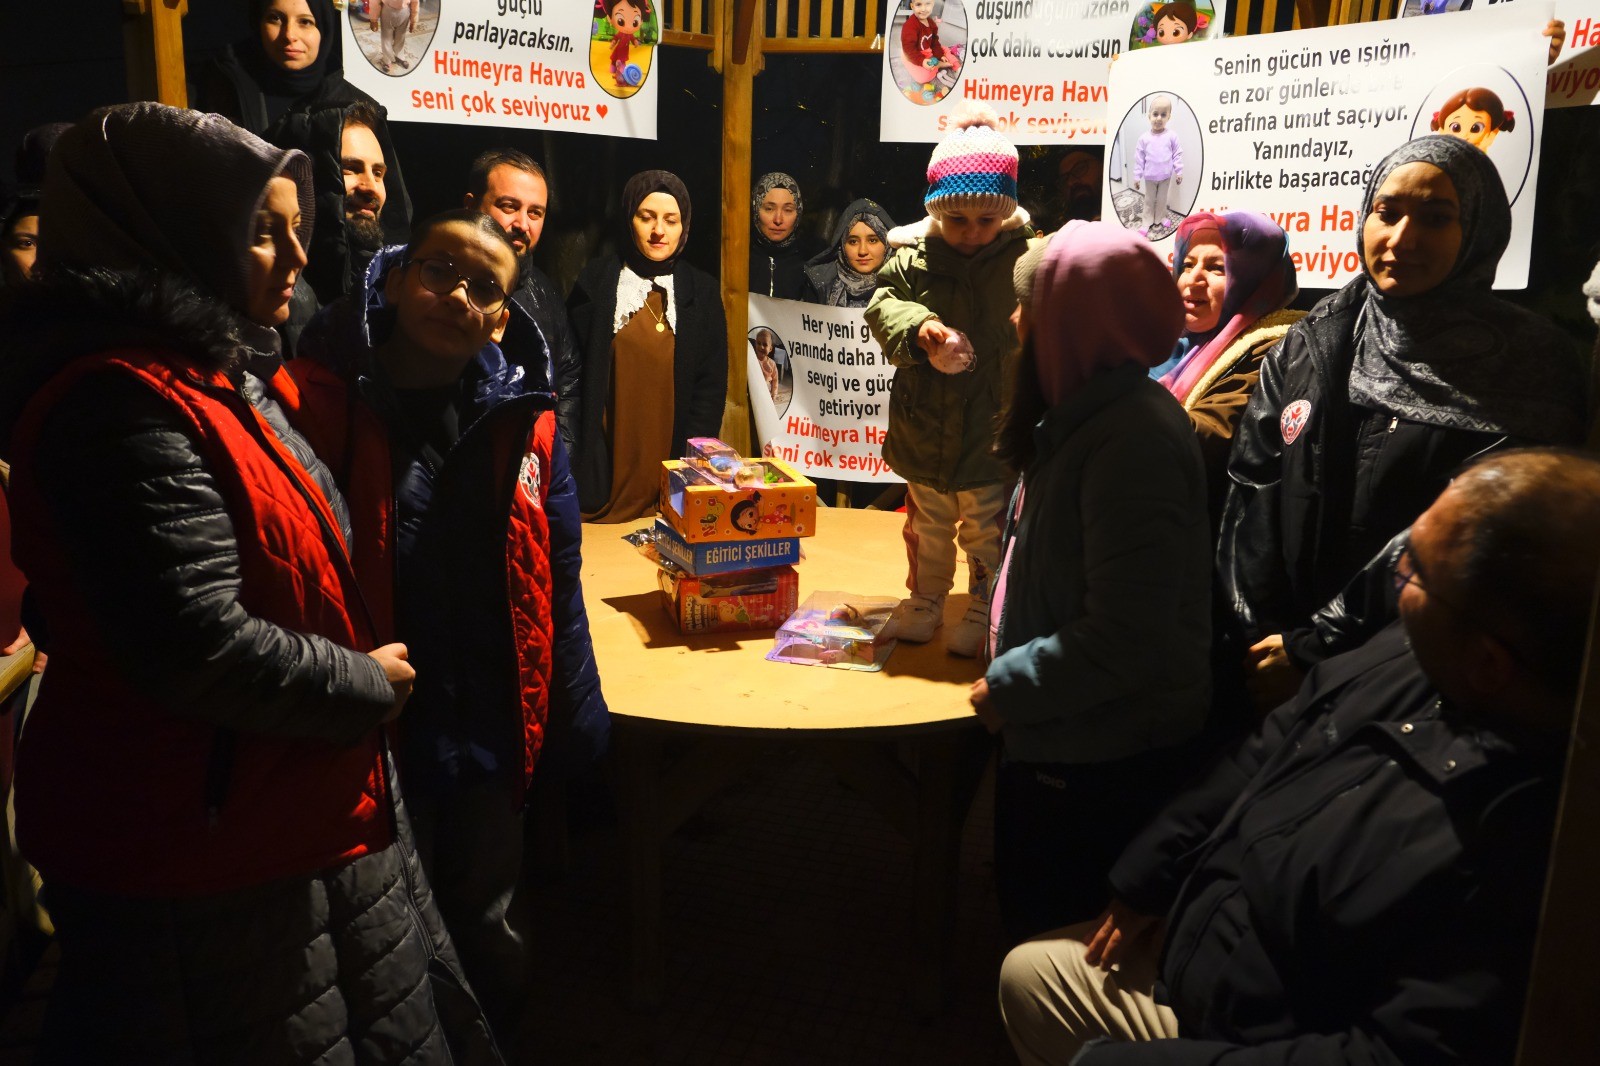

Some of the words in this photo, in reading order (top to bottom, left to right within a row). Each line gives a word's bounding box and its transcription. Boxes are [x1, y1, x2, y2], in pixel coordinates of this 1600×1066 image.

[453, 19, 575, 53] parlayacaksın.
[971, 32, 998, 63] çok
[1003, 32, 1042, 58] daha
[433, 50, 523, 87] Hümeyra
[530, 61, 586, 90] Havva
[1213, 56, 1261, 77] Senin
[1267, 47, 1322, 77] gücün
[1329, 47, 1351, 66] ve
[411, 86, 454, 111] seni
[461, 90, 497, 116] çok
[501, 95, 591, 124] seviyoruz
[963, 78, 1054, 107] Hümeyra
[1219, 88, 1240, 105] en
[1245, 85, 1274, 103] zor
[997, 111, 1020, 133] ok
[1208, 111, 1277, 134] etrafına
[1284, 107, 1331, 130] umut
[1336, 104, 1409, 129] saçıyor.
[1253, 137, 1353, 162] Yanındayız,
[1211, 169, 1273, 191] birlikte
[1320, 204, 1361, 232] Ha
[802, 313, 824, 335] Her
[826, 320, 855, 341] yeni
[788, 339, 834, 364] yanında
[838, 347, 876, 367] daha
[807, 369, 838, 394] sevgi
[842, 376, 861, 392] ve
[819, 397, 882, 420] getiriyor
[786, 415, 860, 448] Hümeyra
[804, 449, 834, 469] çok
[706, 544, 742, 565] EĞİTİCİ
[745, 541, 791, 563] ŞEKİLLER
